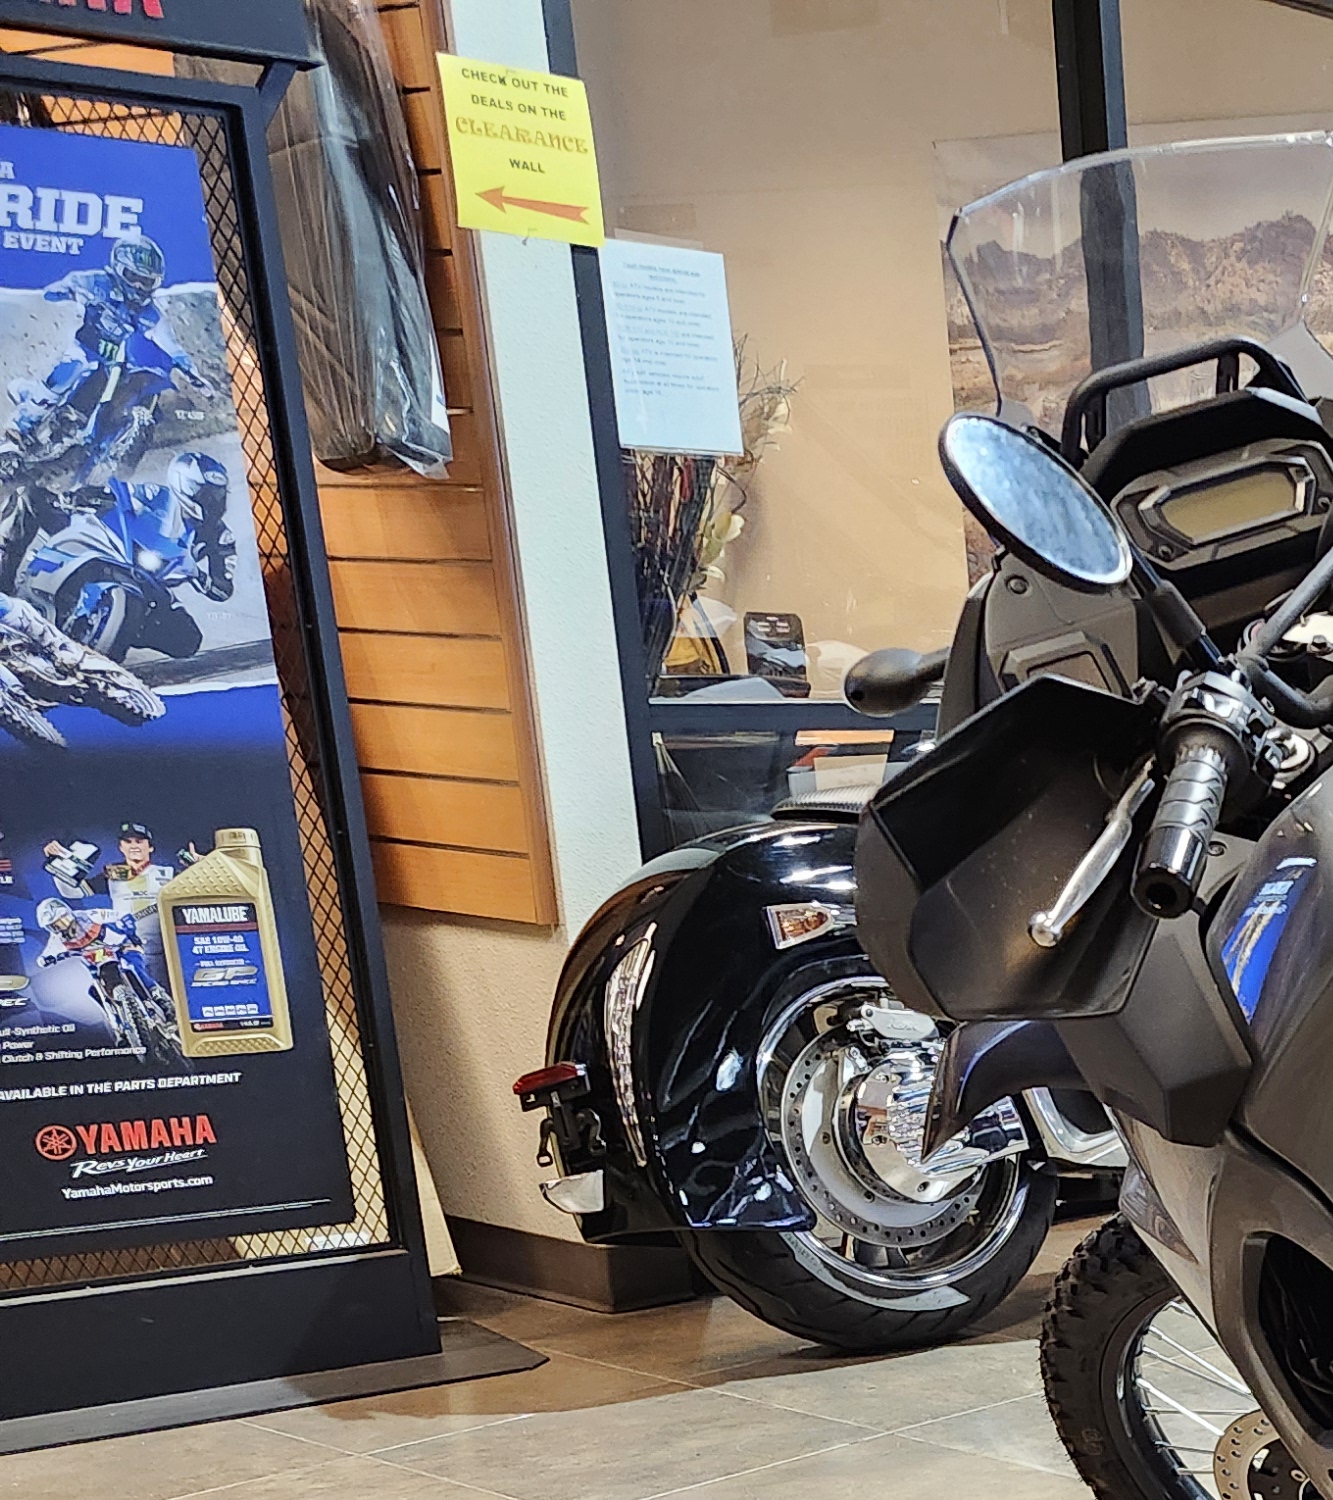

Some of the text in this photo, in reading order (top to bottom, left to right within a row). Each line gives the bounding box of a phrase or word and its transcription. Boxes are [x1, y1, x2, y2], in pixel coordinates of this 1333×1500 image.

[461, 67, 569, 98] CHECK OUT THE
[471, 94, 567, 121] DEALS ON THE
[455, 116, 589, 154] CLEARANCE
[509, 158, 546, 174] WALL
[0, 183, 144, 240] RIDE
[3, 230, 84, 255] EVENT
[181, 906, 250, 925] YAMALUBE
[2, 1041, 35, 1050] Power
[84, 1046, 147, 1057] Performance
[0, 1072, 242, 1101] AVAILABLE IN THE PARTS DEPARTMENT
[75, 1113, 217, 1155] YAMAHA
[70, 1148, 206, 1178] Revs Your Heart
[61, 1175, 214, 1200] YamahaMotorsports.com
